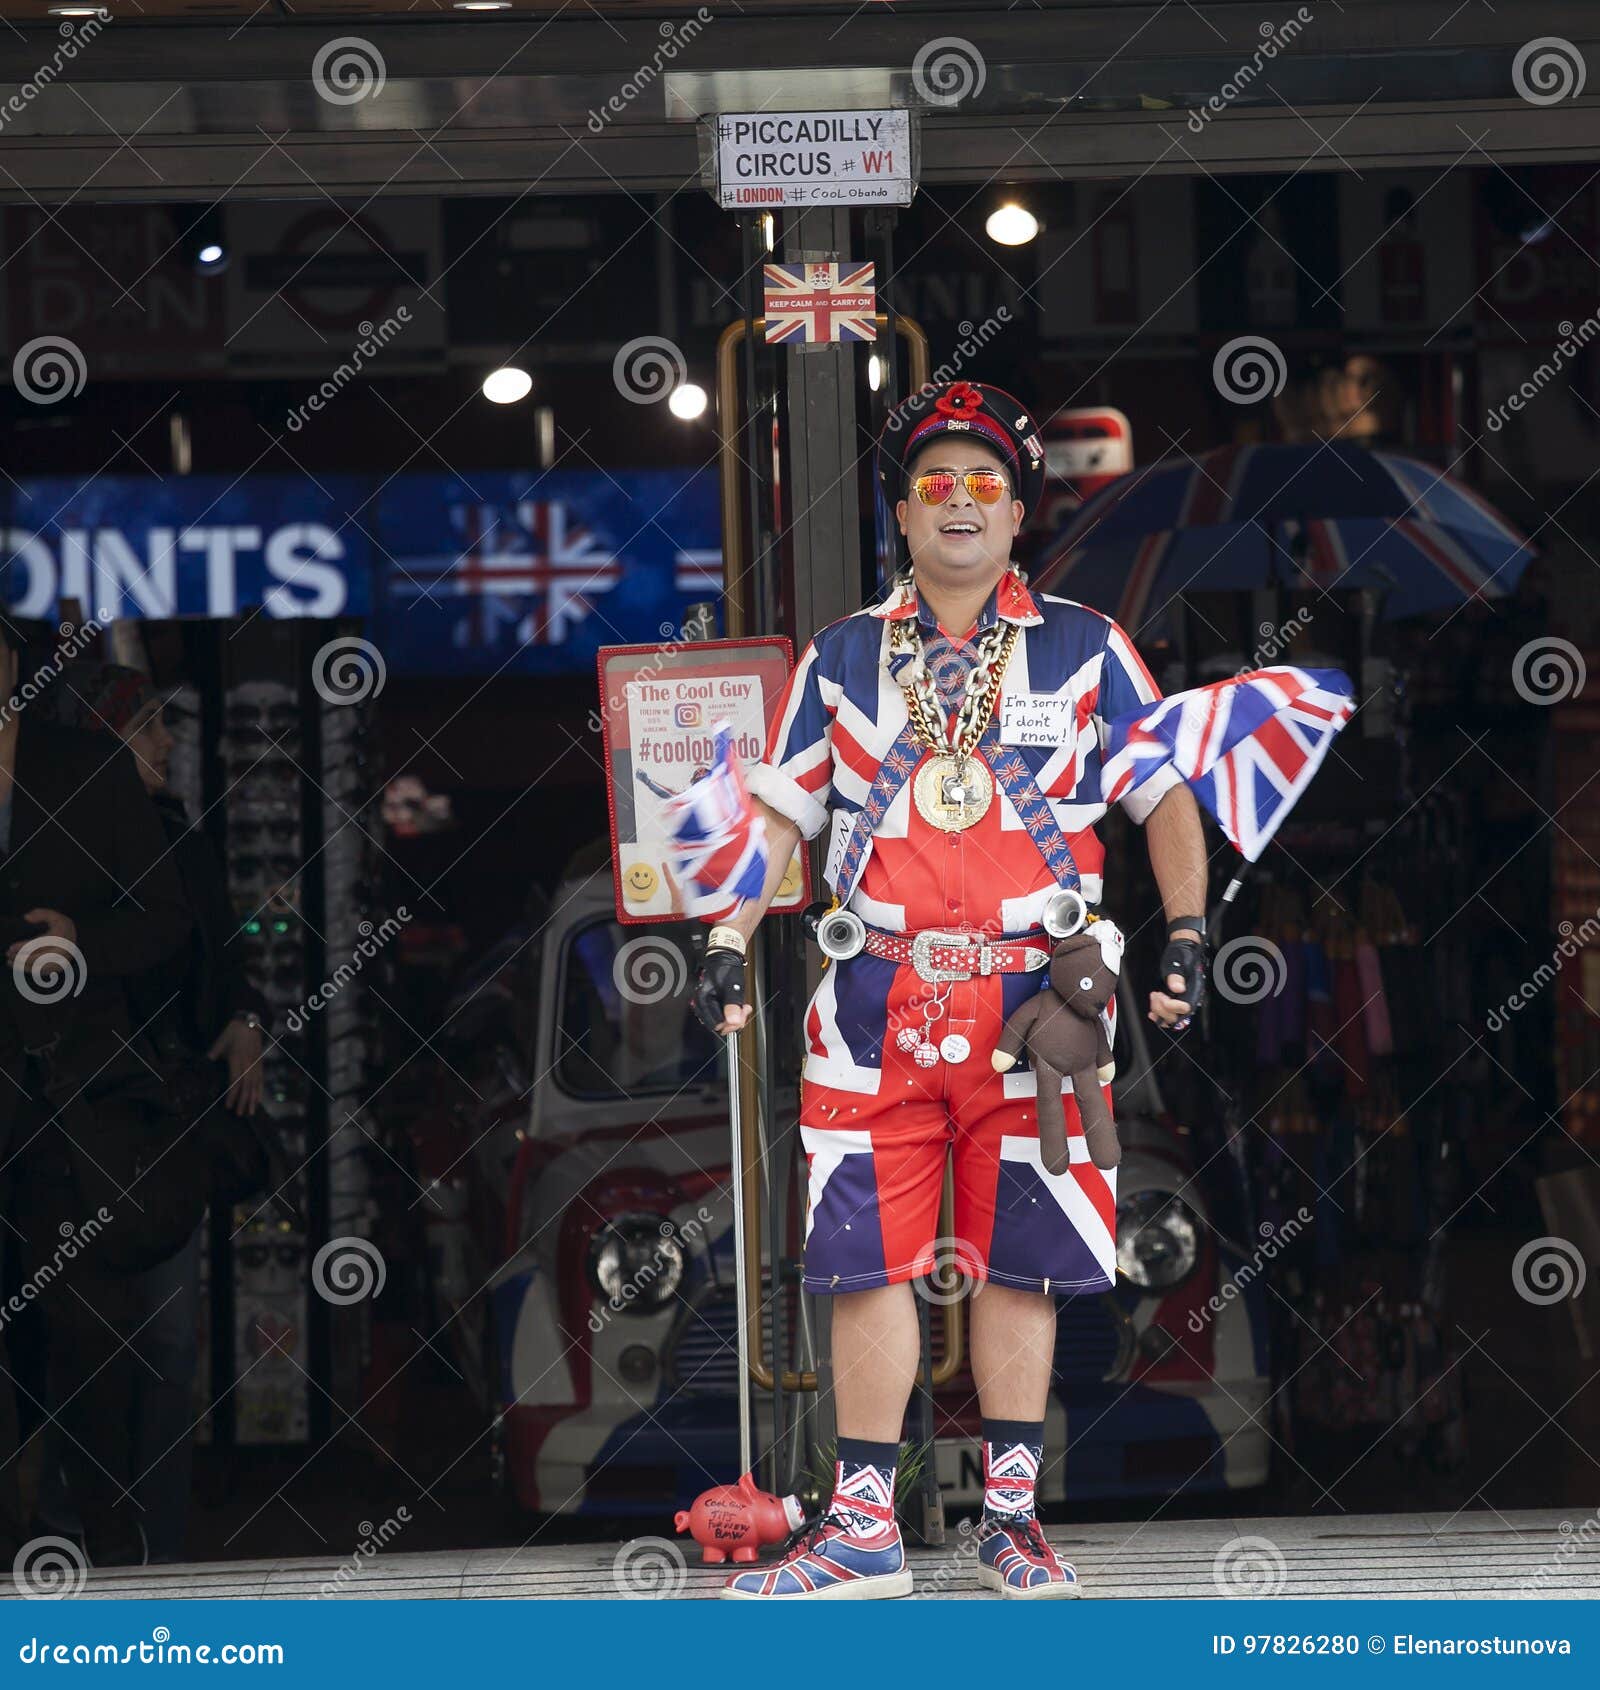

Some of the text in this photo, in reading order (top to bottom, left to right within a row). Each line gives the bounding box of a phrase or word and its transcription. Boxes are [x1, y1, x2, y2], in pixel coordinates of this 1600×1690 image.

[769, 300, 789, 308] KEEP
[640, 680, 752, 701] The Cool Guy
[1004, 694, 1069, 713] I'm sorry
[1002, 713, 1051, 727] I don't
[639, 732, 760, 764] #coolobdo
